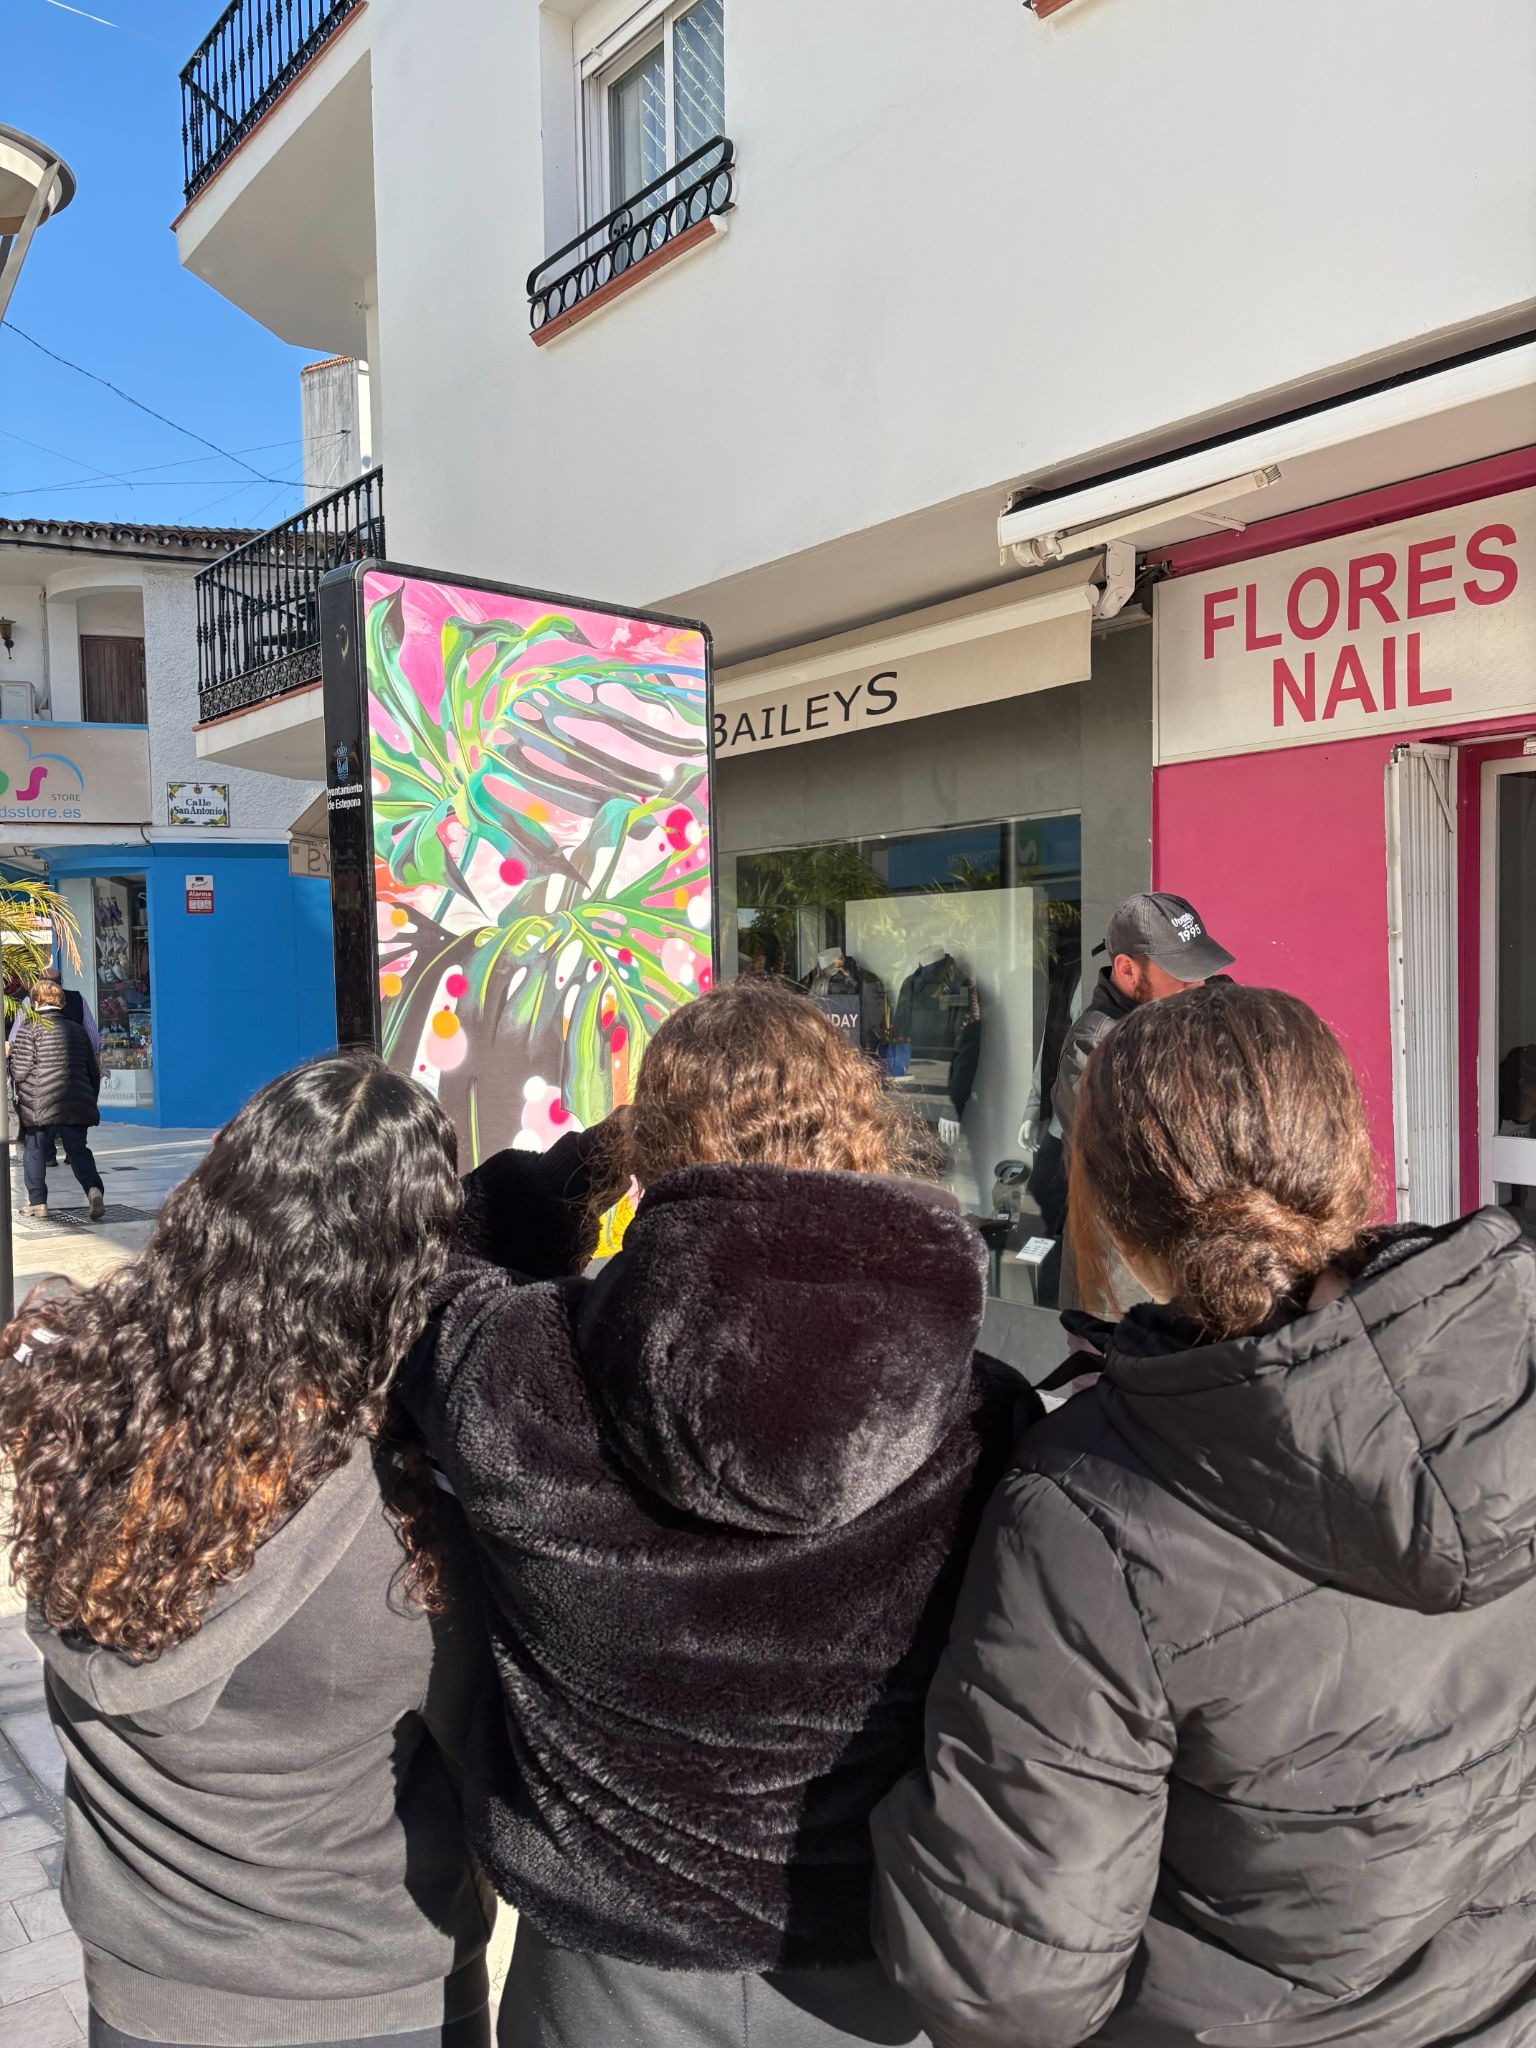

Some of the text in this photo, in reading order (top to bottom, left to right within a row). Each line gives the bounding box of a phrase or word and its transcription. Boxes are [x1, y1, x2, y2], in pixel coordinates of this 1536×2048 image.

[1204, 523, 1518, 660] FLORES
[1273, 632, 1452, 728] NAIL
[714, 671, 898, 749] BAILEYS
[51, 793, 80, 802] STORE
[185, 798, 212, 807] Calle
[335, 798, 361, 810] Estepona
[1177, 924, 1202, 942] 1995
